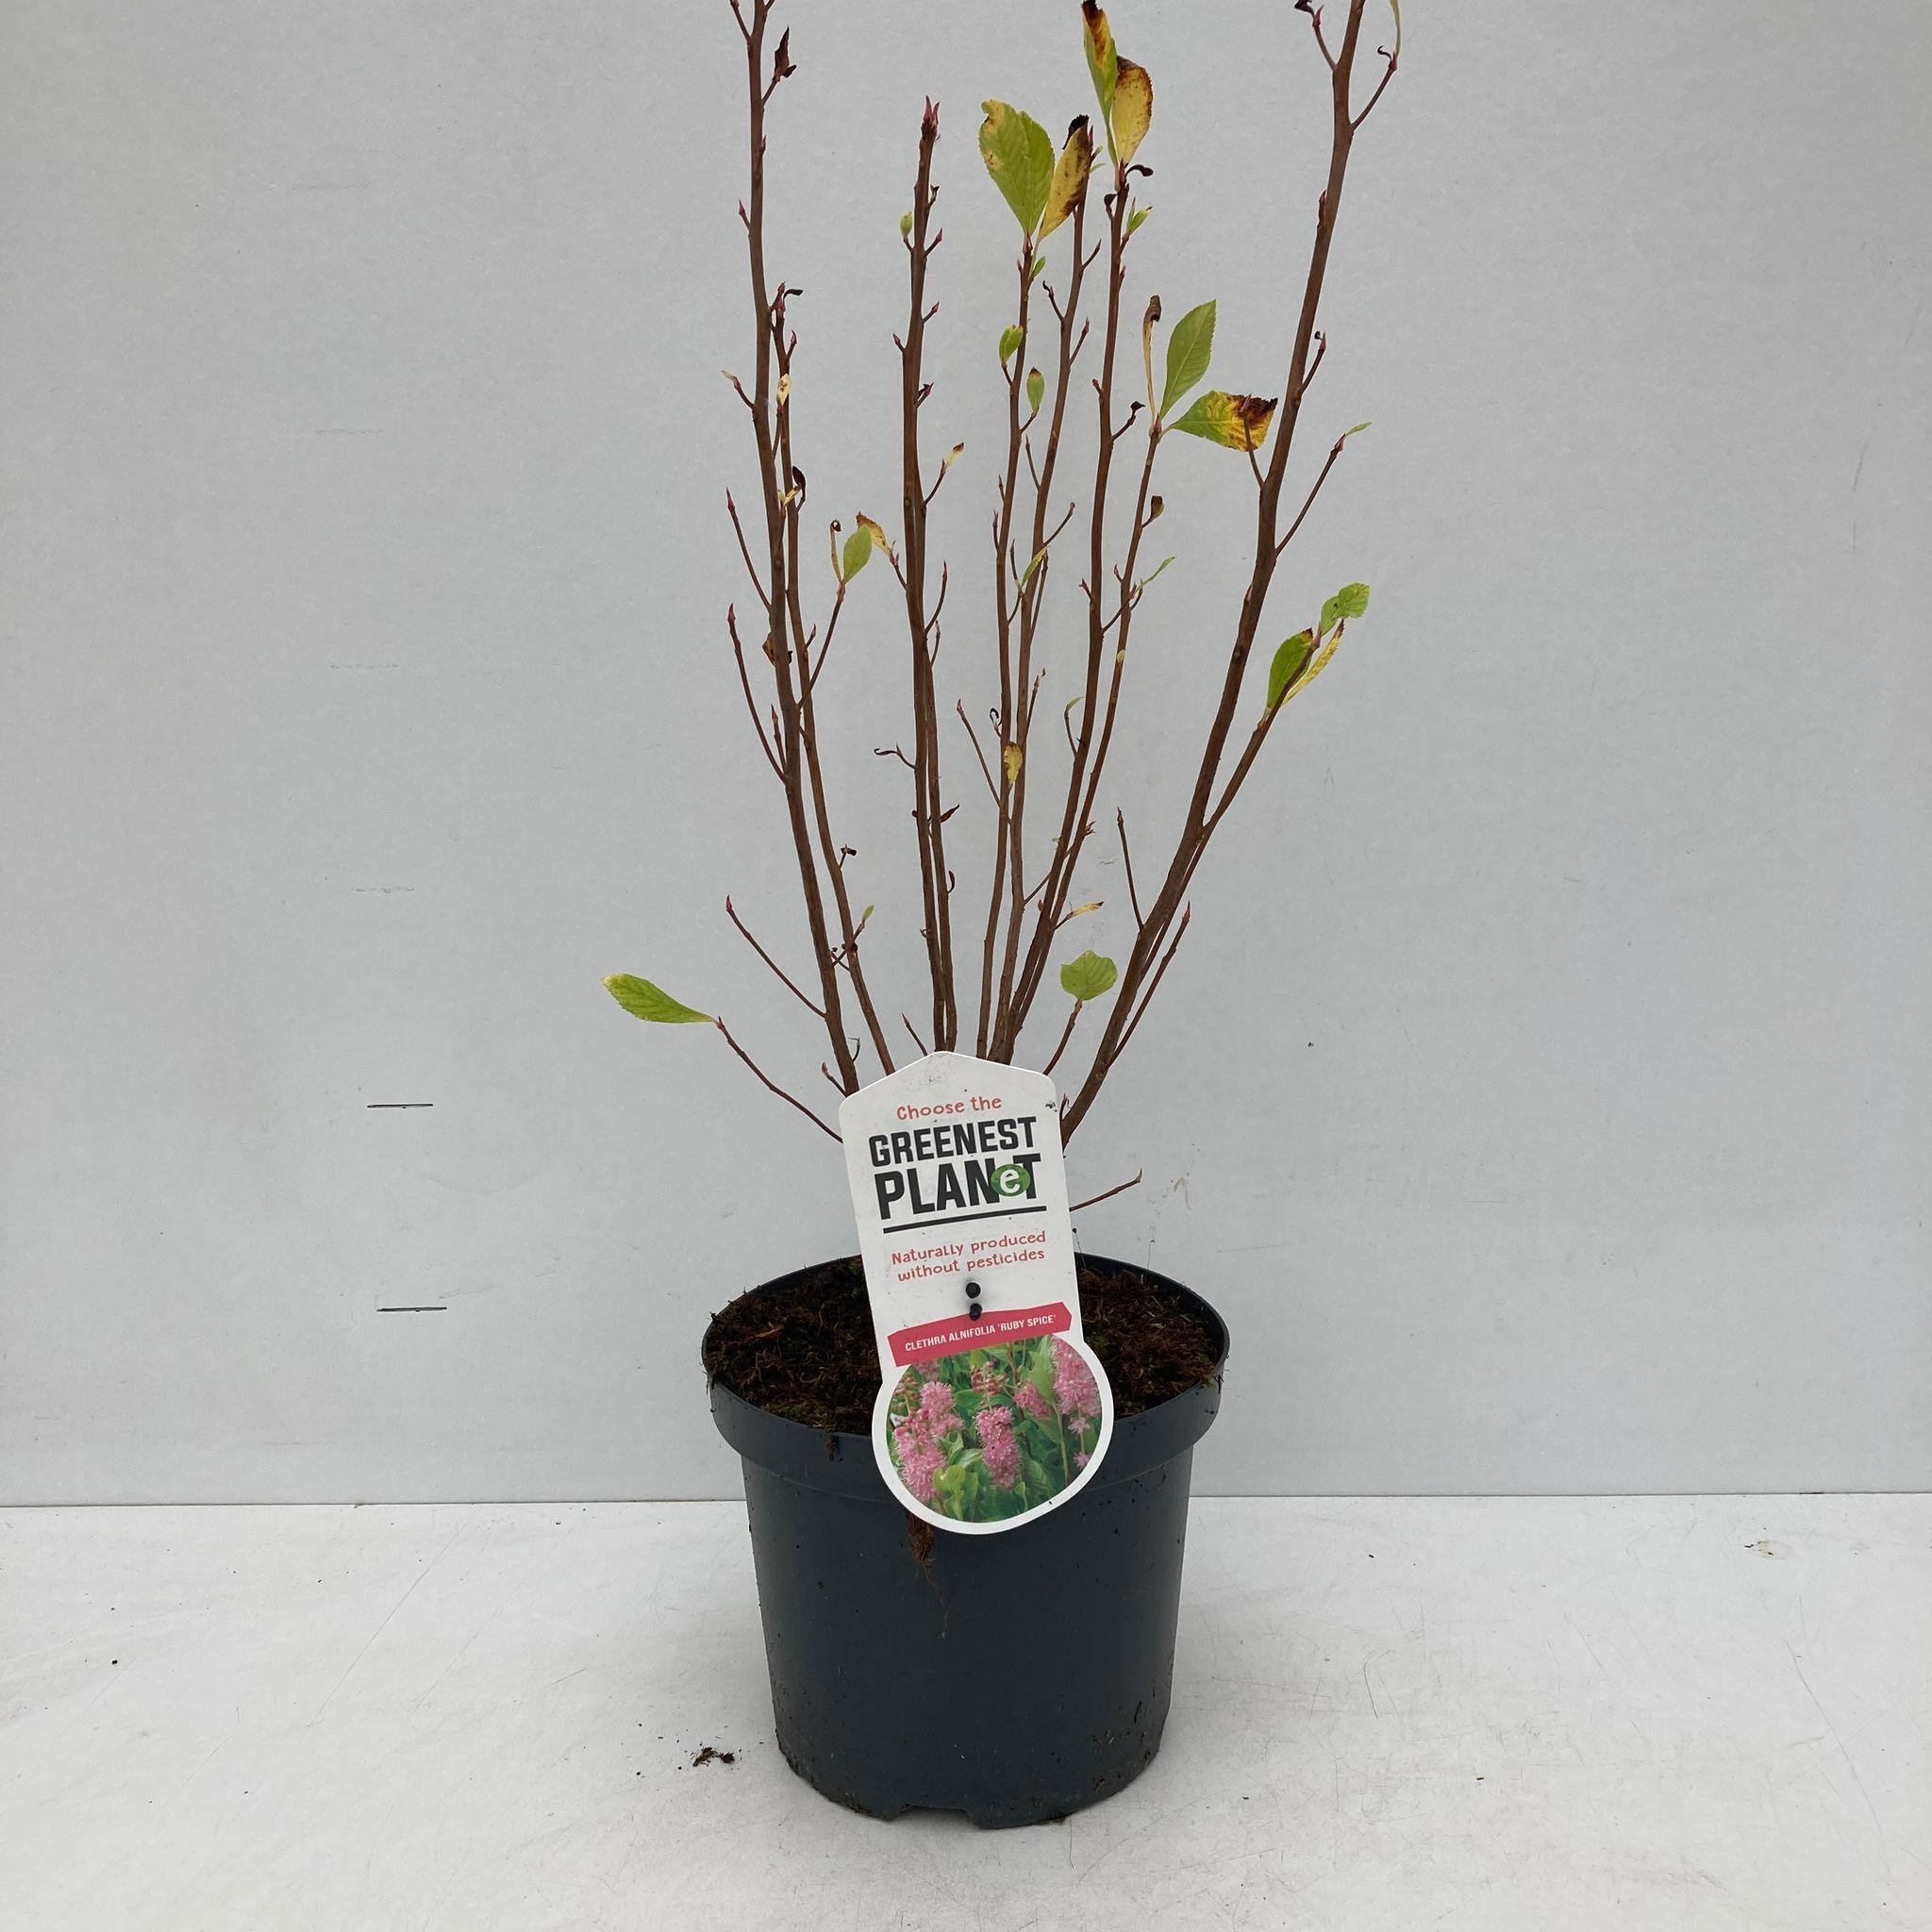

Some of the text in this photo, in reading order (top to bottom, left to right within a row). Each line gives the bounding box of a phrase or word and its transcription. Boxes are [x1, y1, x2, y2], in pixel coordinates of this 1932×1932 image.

[896, 1095, 1002, 1121] Choose the
[868, 1116, 1037, 1167] GREENEST
[891, 1230, 1046, 1265] Naturally produced
[897, 1249, 1045, 1282] without pesticides
[905, 1314, 1057, 1352] CLETHRA ALNIFOLIA 'RUBY SPICE'
